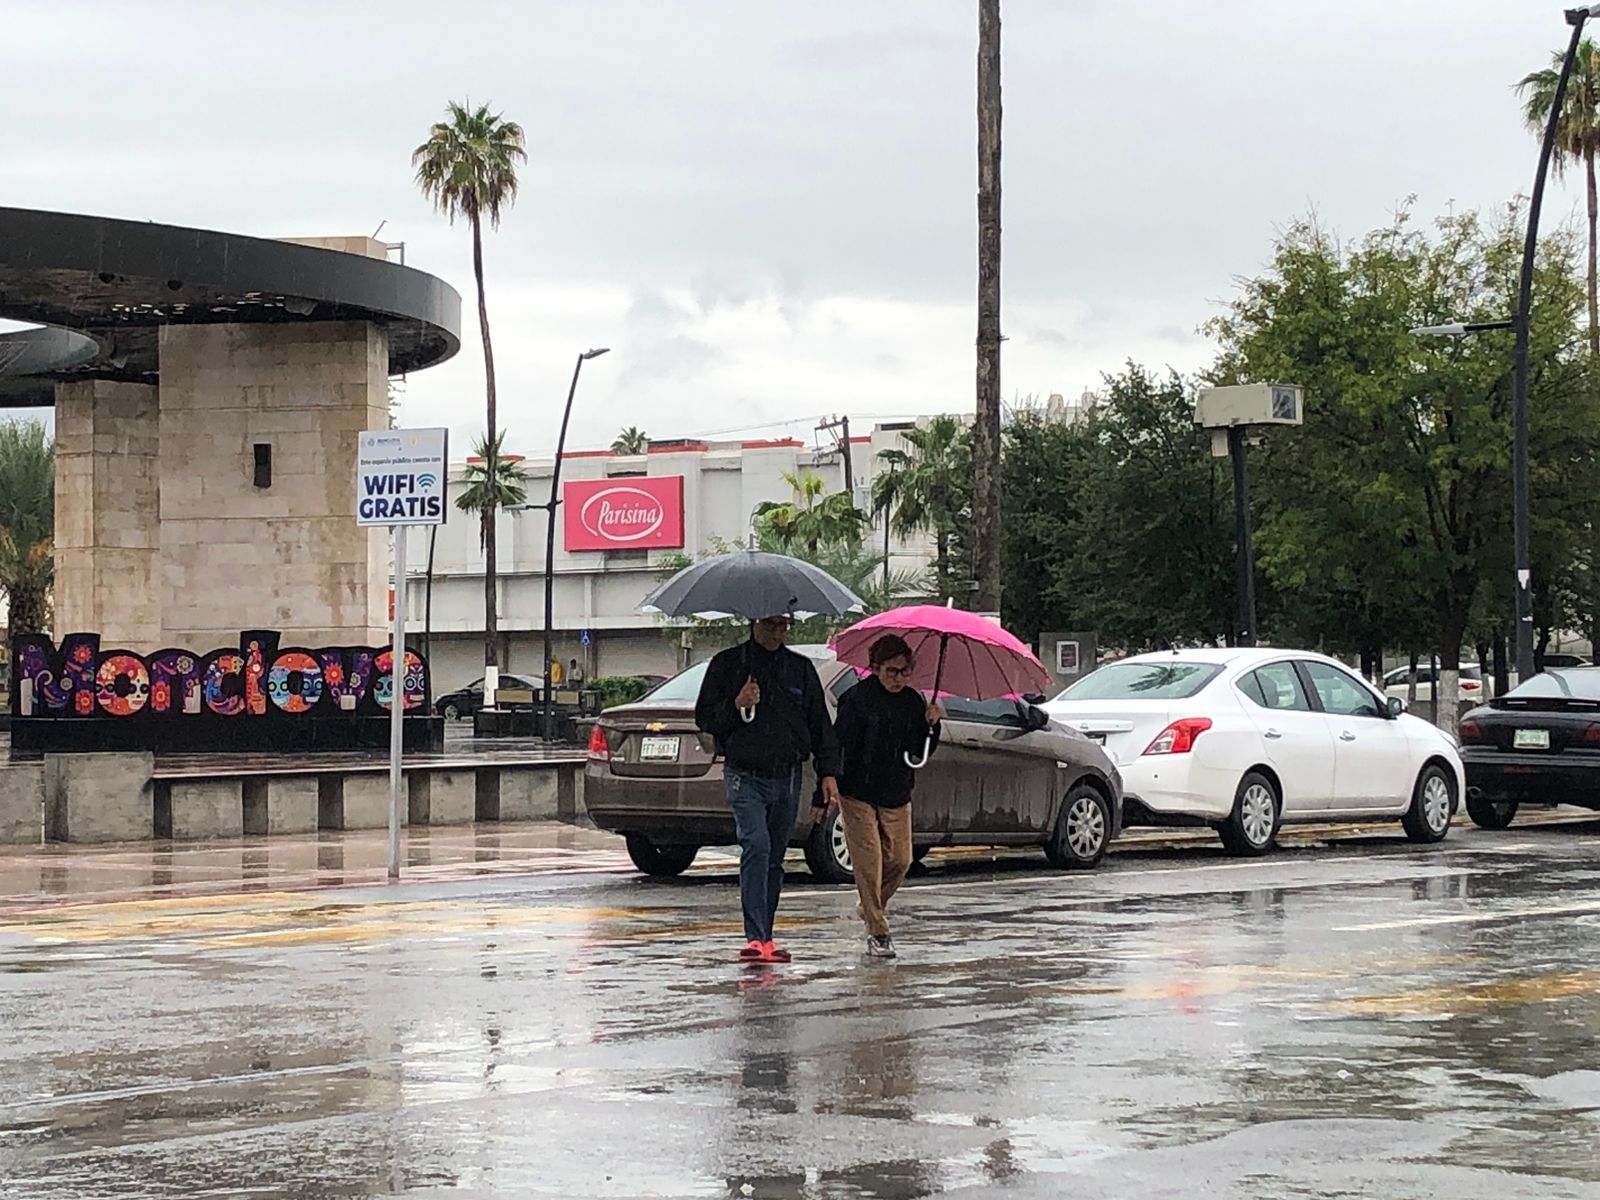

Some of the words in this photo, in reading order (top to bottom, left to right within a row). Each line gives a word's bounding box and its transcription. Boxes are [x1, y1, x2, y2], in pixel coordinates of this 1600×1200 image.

[364, 474, 415, 495] WIFI
[359, 496, 440, 519] GRATIS
[600, 500, 657, 525] Parisina
[13, 631, 428, 717] Monclova
